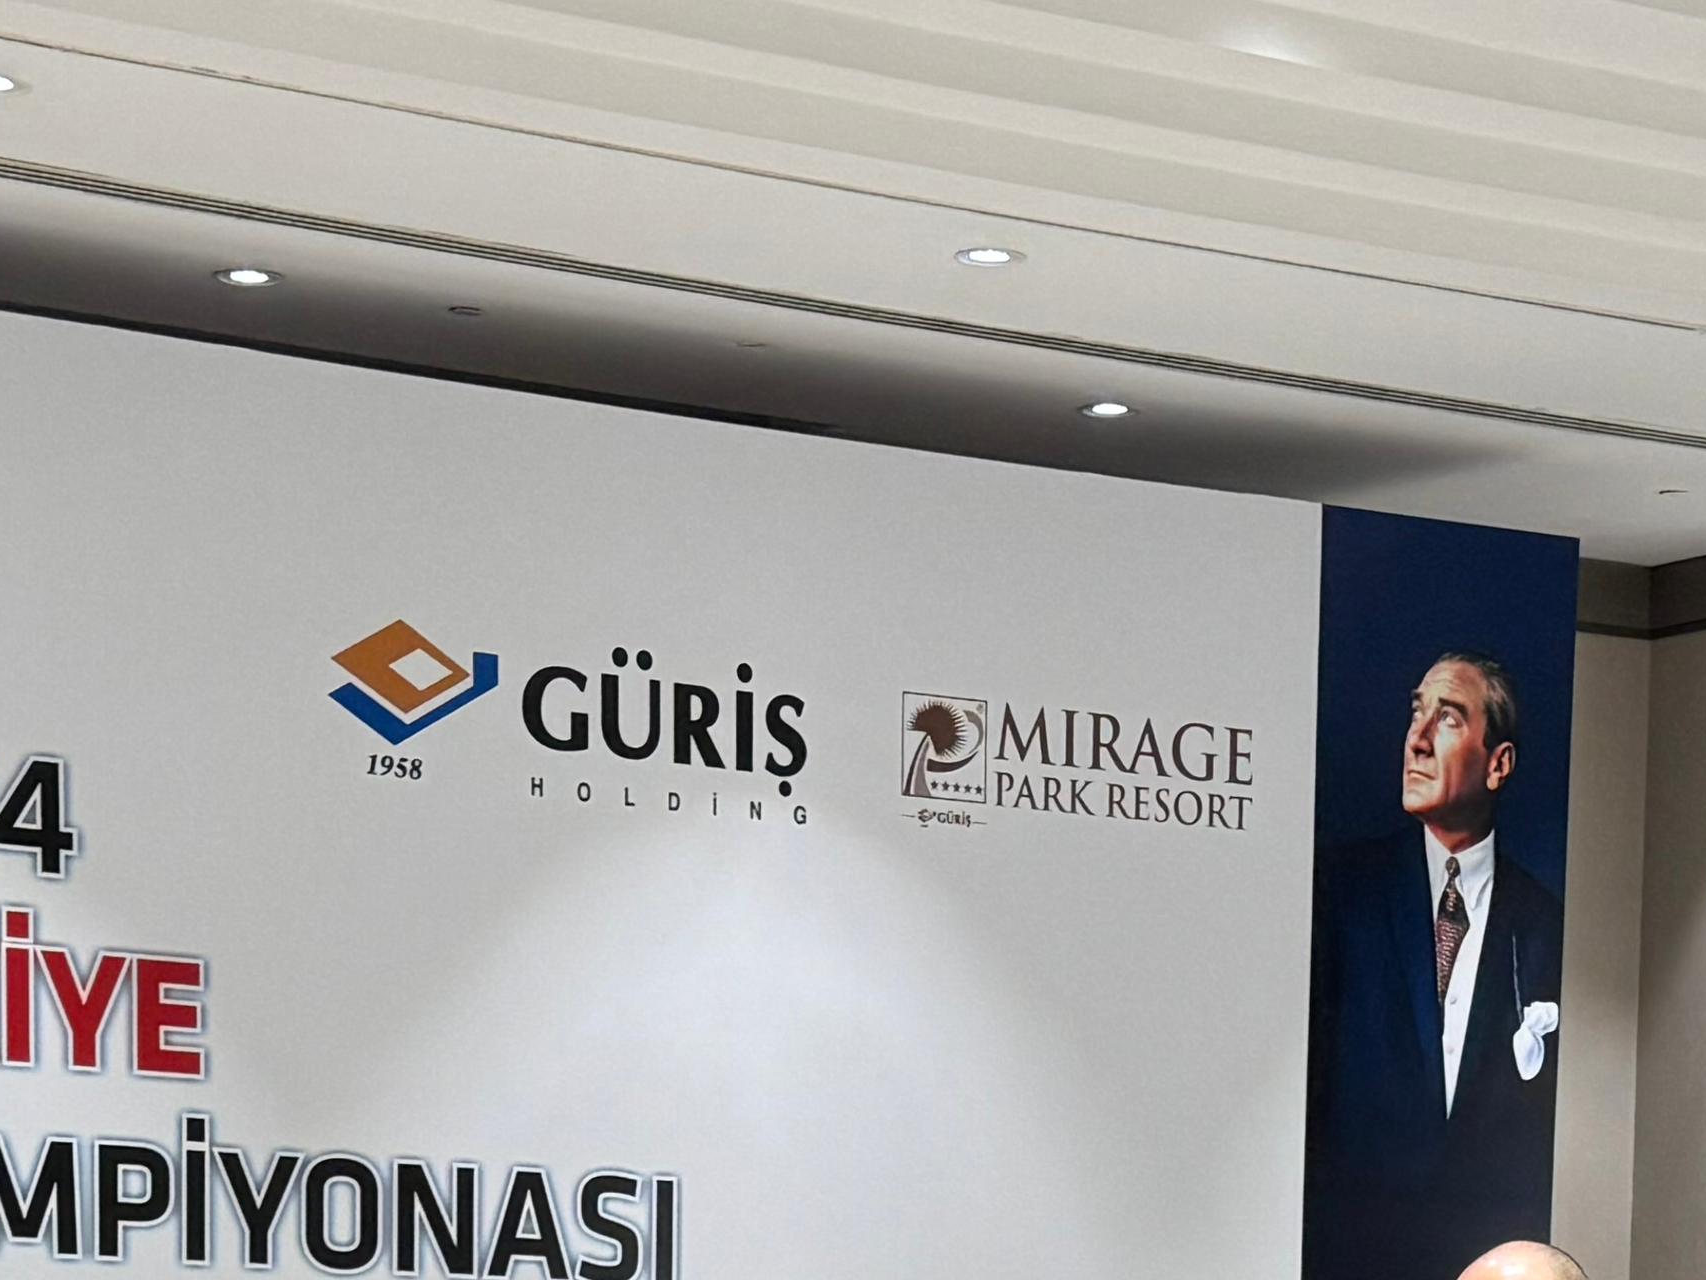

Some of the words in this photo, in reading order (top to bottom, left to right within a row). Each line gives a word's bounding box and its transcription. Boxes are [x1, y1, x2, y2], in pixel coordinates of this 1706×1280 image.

[522, 646, 808, 798] GÜRİŞ
[994, 702, 1253, 786] MIRAGE
[366, 753, 423, 781] 1958
[994, 771, 1096, 817] PARK
[1105, 783, 1253, 831] RESORT
